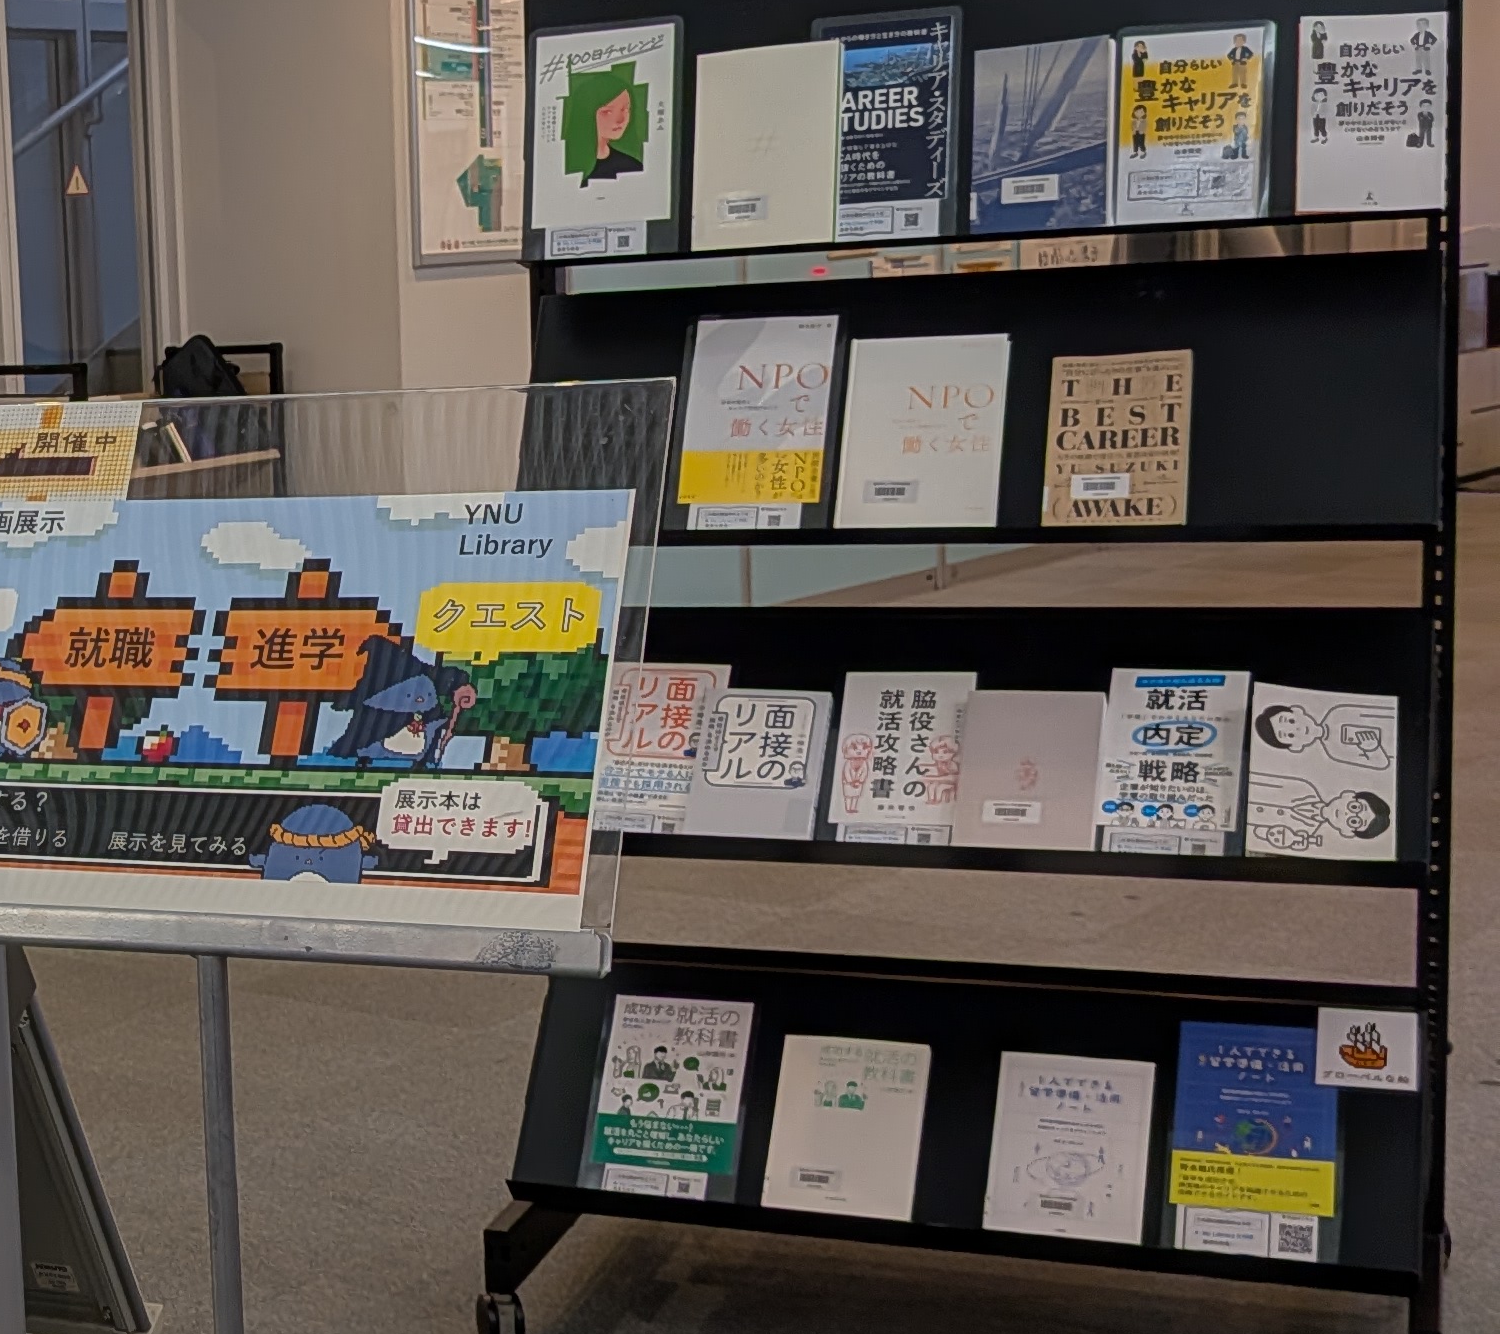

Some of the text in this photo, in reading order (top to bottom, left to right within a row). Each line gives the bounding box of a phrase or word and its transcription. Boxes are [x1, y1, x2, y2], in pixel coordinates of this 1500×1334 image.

[1340, 43, 1405, 58] 自分らしい
[1159, 59, 1222, 75] 自分らしい
[1313, 61, 1378, 85] 豊かな
[841, 86, 919, 111] AREER
[1134, 77, 1196, 102] 豊かな
[1343, 78, 1437, 98] キャリアを
[1162, 92, 1252, 113] キャリアを
[1336, 101, 1408, 117] 創りだそう
[841, 106, 924, 133] TUDIES
[1155, 114, 1225, 132] 創りだそう
[738, 362, 829, 390] NPO
[1061, 374, 1183, 397] THE
[790, 394, 810, 413] で
[908, 383, 995, 410] NPO
[957, 413, 979, 431] で
[1060, 403, 1182, 427] BEST
[730, 418, 824, 438] 働く女性
[1056, 426, 1180, 451] CAREER
[32, 432, 117, 454] 開催中
[902, 435, 990, 455] 働く女性
[464, 503, 524, 525] YNU
[459, 534, 553, 559] Library
[433, 598, 585, 634] クエスト
[65, 627, 156, 669] 就職
[250, 627, 346, 670] 進学
[1145, 689, 1209, 711] 就活
[621, 677, 659, 749] リアル
[657, 677, 698, 751] 面接の
[720, 703, 757, 779] リアル
[756, 704, 798, 781] 面接の
[870, 689, 905, 799] 就活攻略書
[903, 689, 937, 798] 脇役さんの
[1142, 723, 1204, 747] 内定
[1138, 759, 1200, 783] 戦略
[395, 789, 482, 811] 展示本は
[108, 830, 248, 856] 展示を見てみる
[673, 1026, 738, 1049] 教科書
